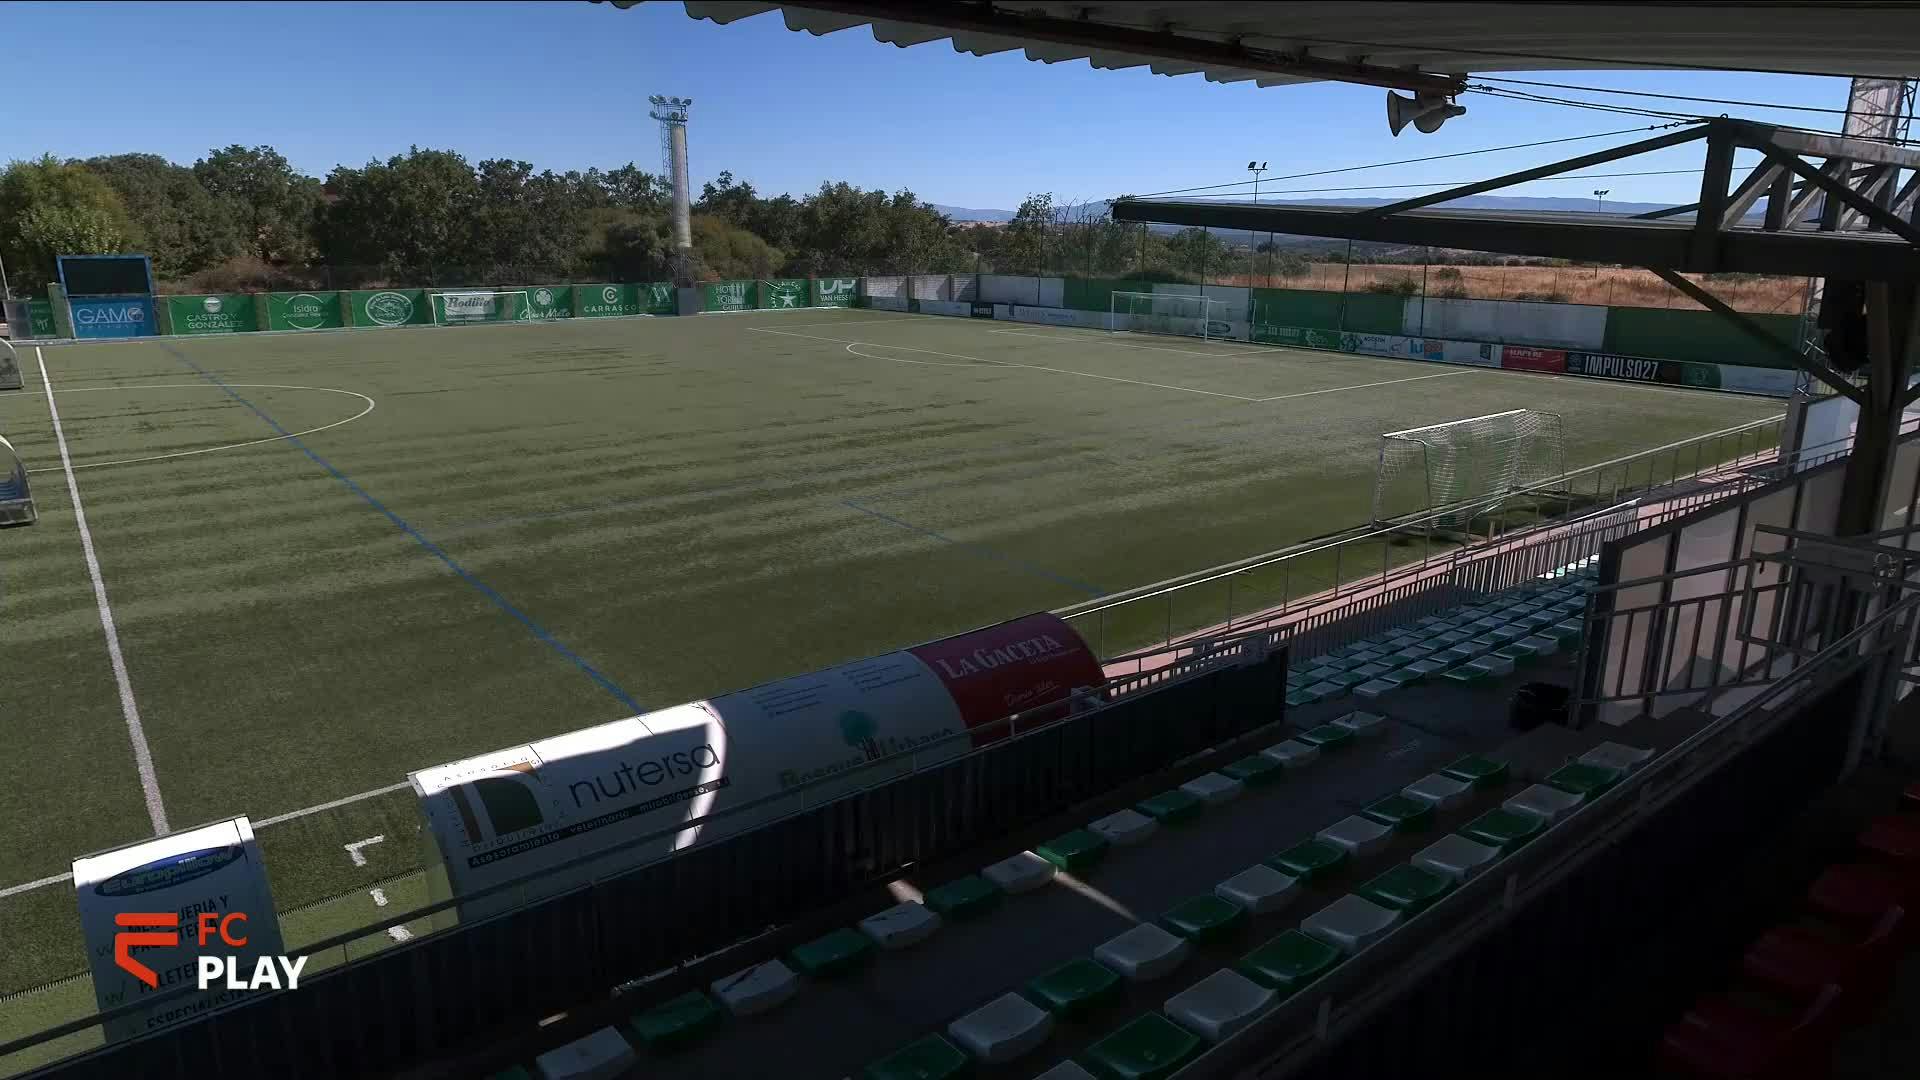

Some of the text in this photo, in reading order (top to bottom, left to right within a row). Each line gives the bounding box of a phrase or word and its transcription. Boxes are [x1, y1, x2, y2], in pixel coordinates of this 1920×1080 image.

[77, 307, 144, 324] GAMO
[584, 304, 636, 312] CARRASCO
[187, 313, 228, 321] CASTRO
[1585, 355, 1660, 380] IMPULSO27
[569, 743, 721, 808] nutersa
